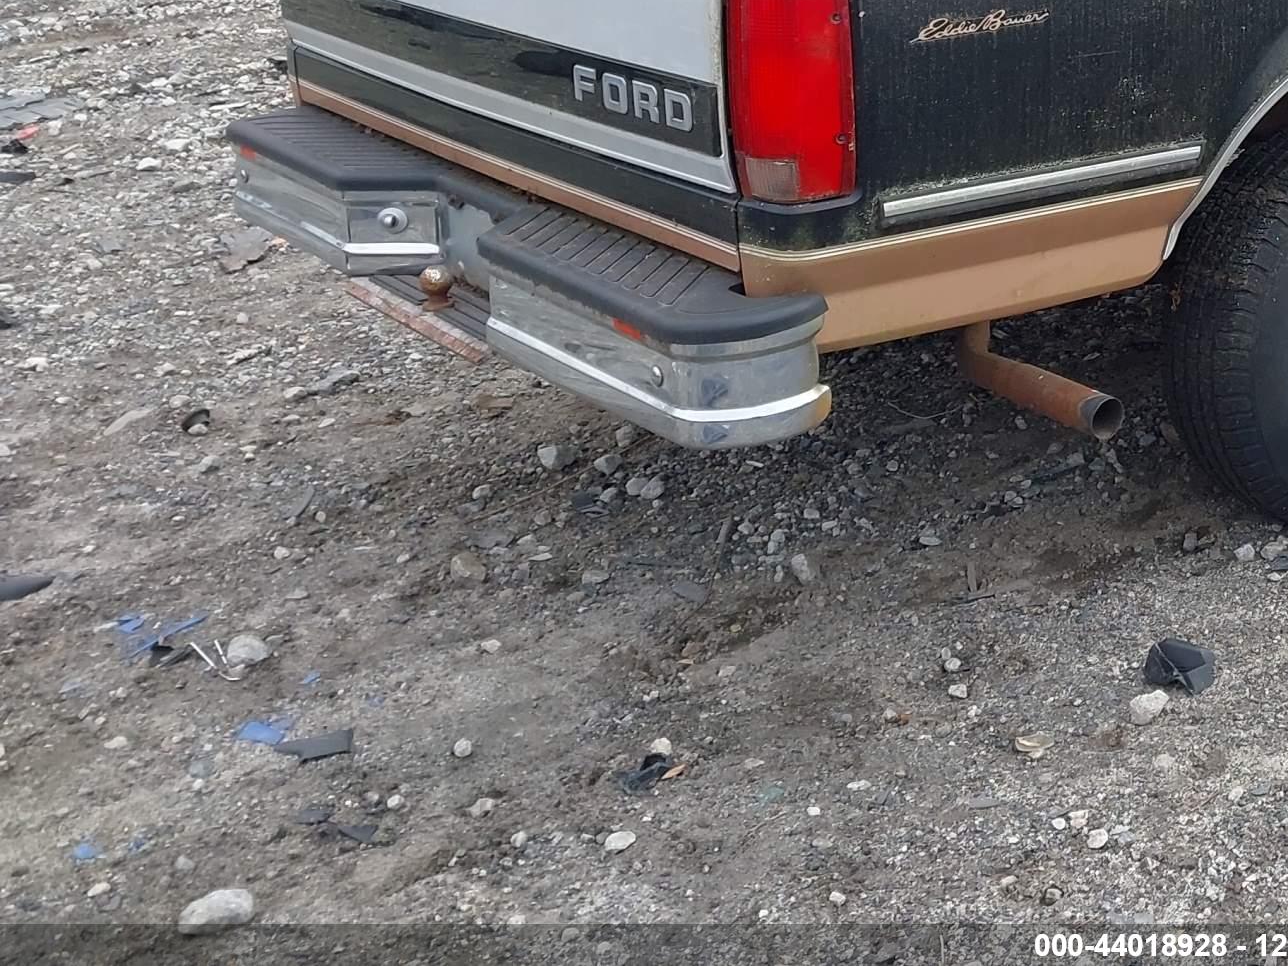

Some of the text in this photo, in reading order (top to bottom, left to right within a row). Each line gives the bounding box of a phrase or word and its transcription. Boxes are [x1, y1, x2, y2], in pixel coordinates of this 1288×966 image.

[909, 9, 1049, 43] Eddie Bauer
[573, 64, 693, 132] FORD
